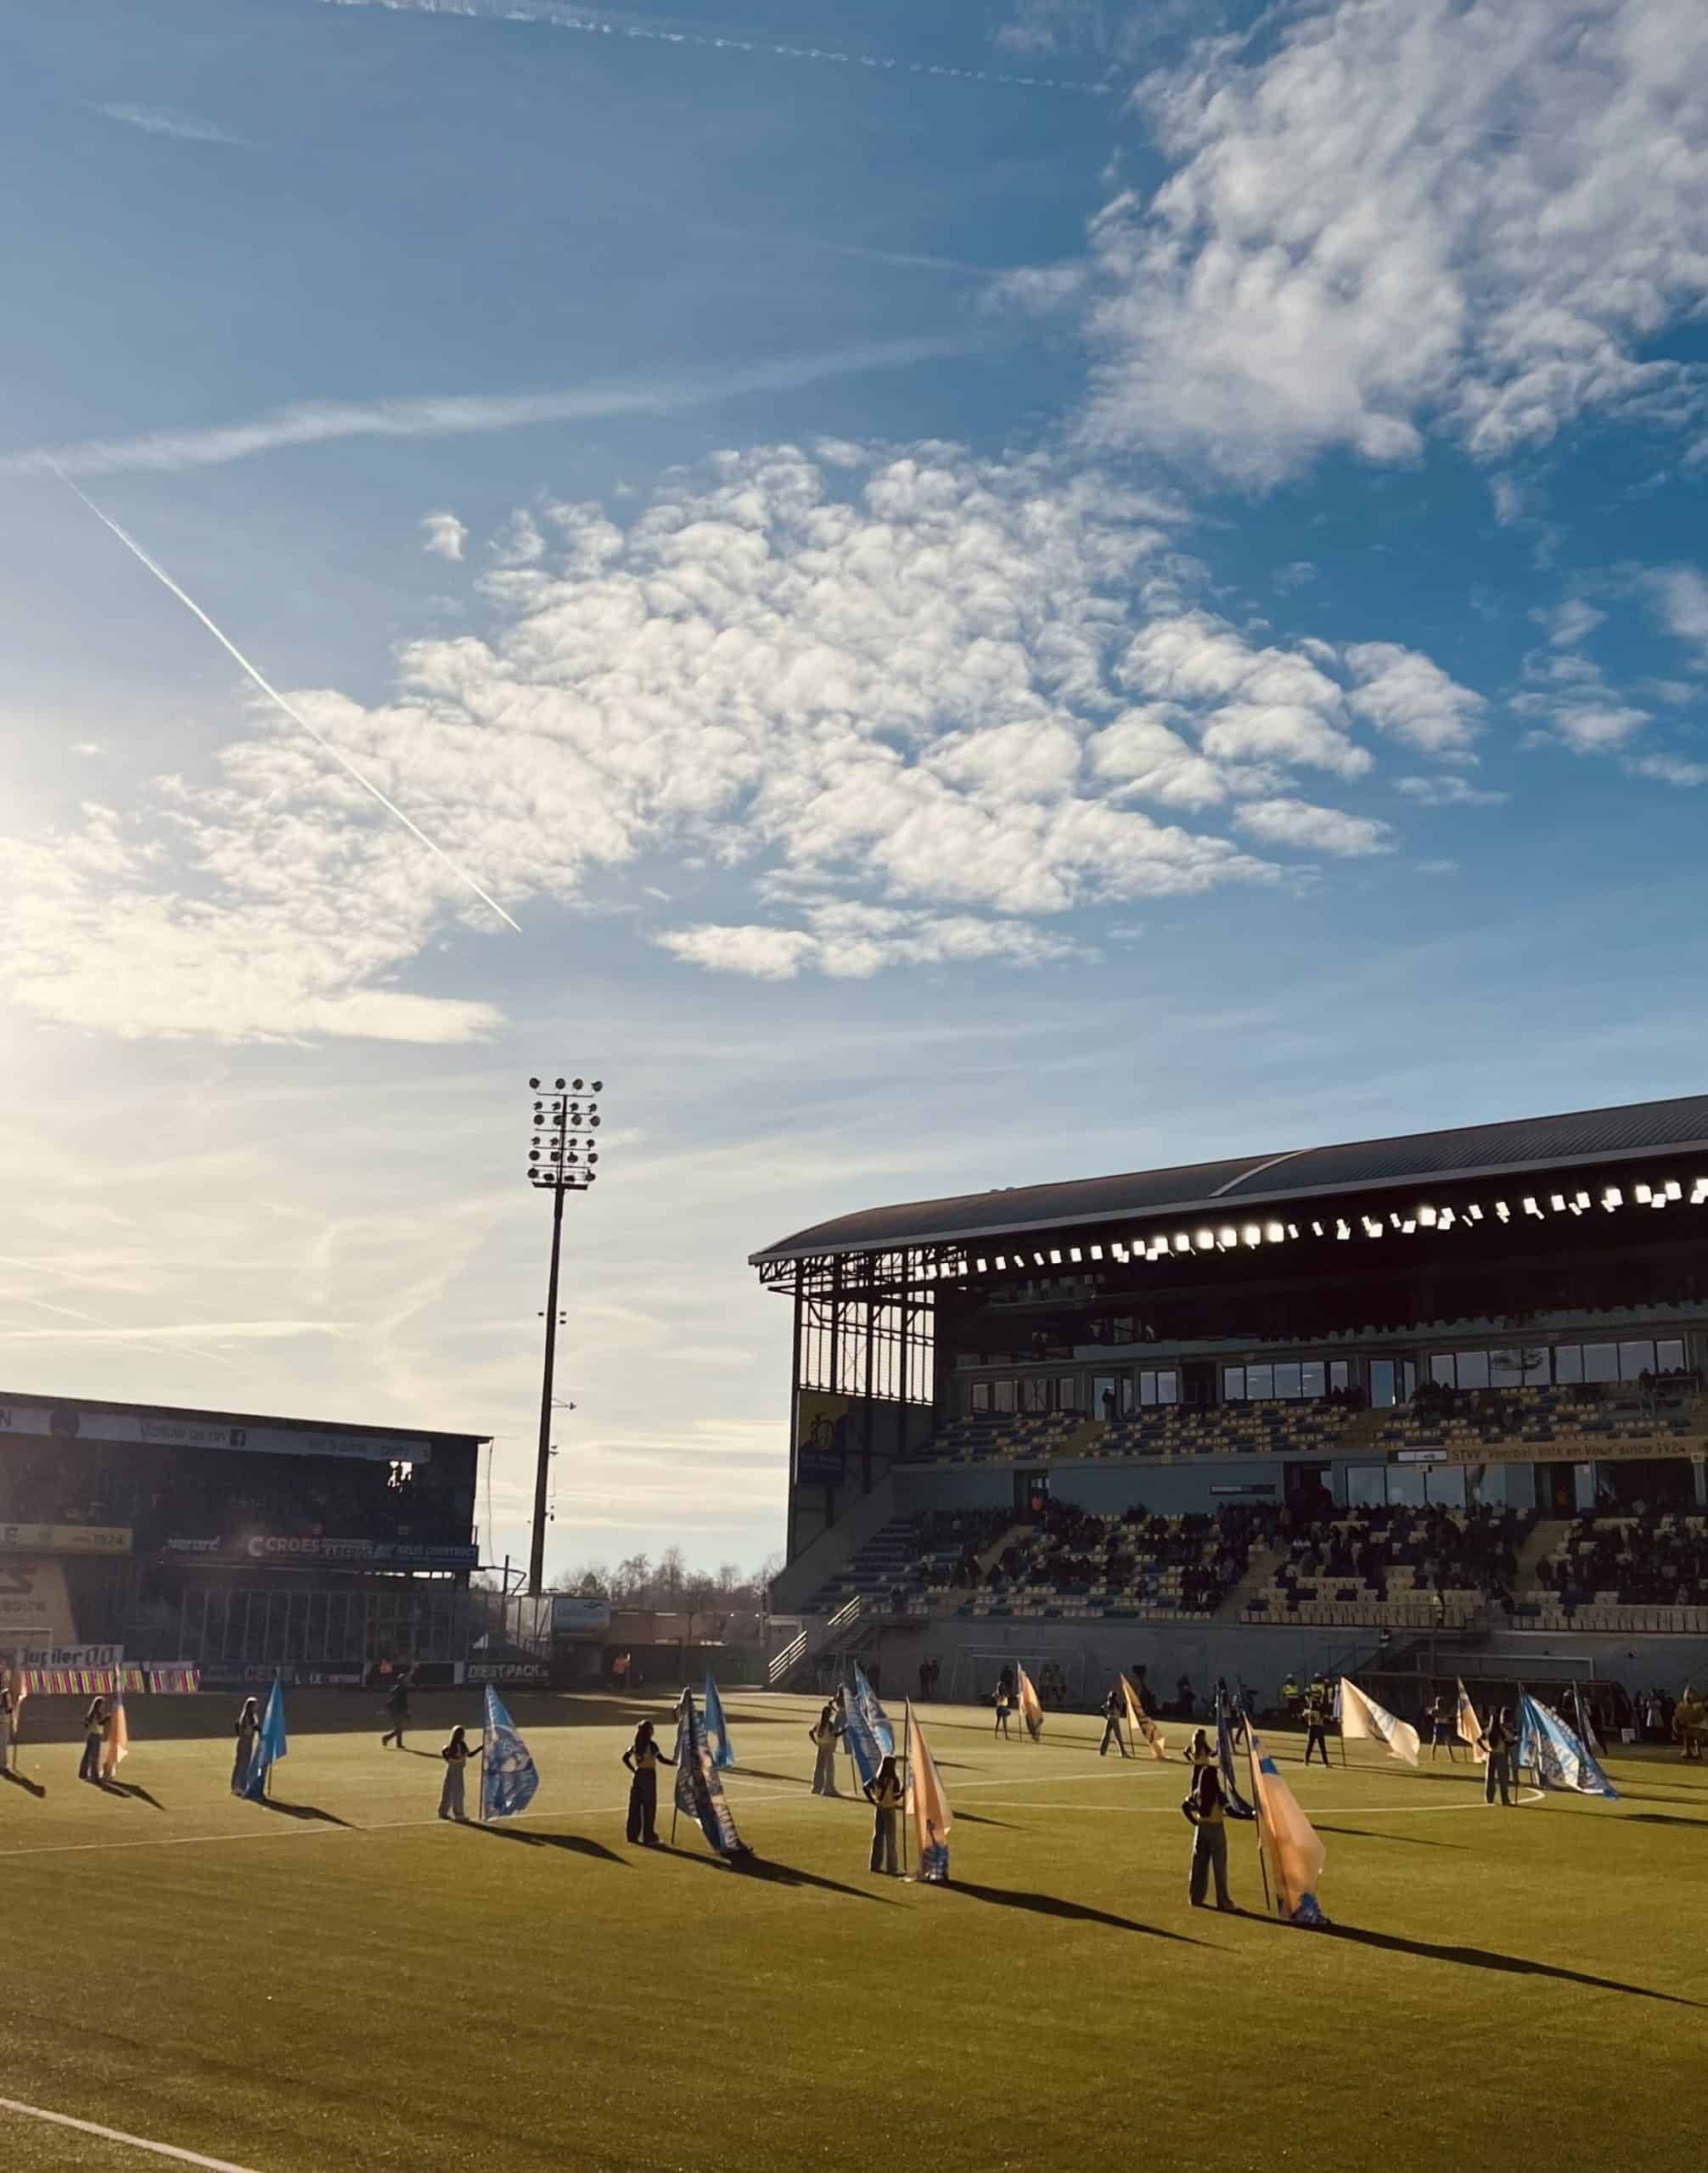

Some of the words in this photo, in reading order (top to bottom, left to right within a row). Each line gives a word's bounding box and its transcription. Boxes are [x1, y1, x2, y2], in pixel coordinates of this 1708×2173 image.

[1452, 1449, 1481, 1461] STVV
[1619, 1444, 1652, 1455] since
[266, 1537, 318, 1553] CROES
